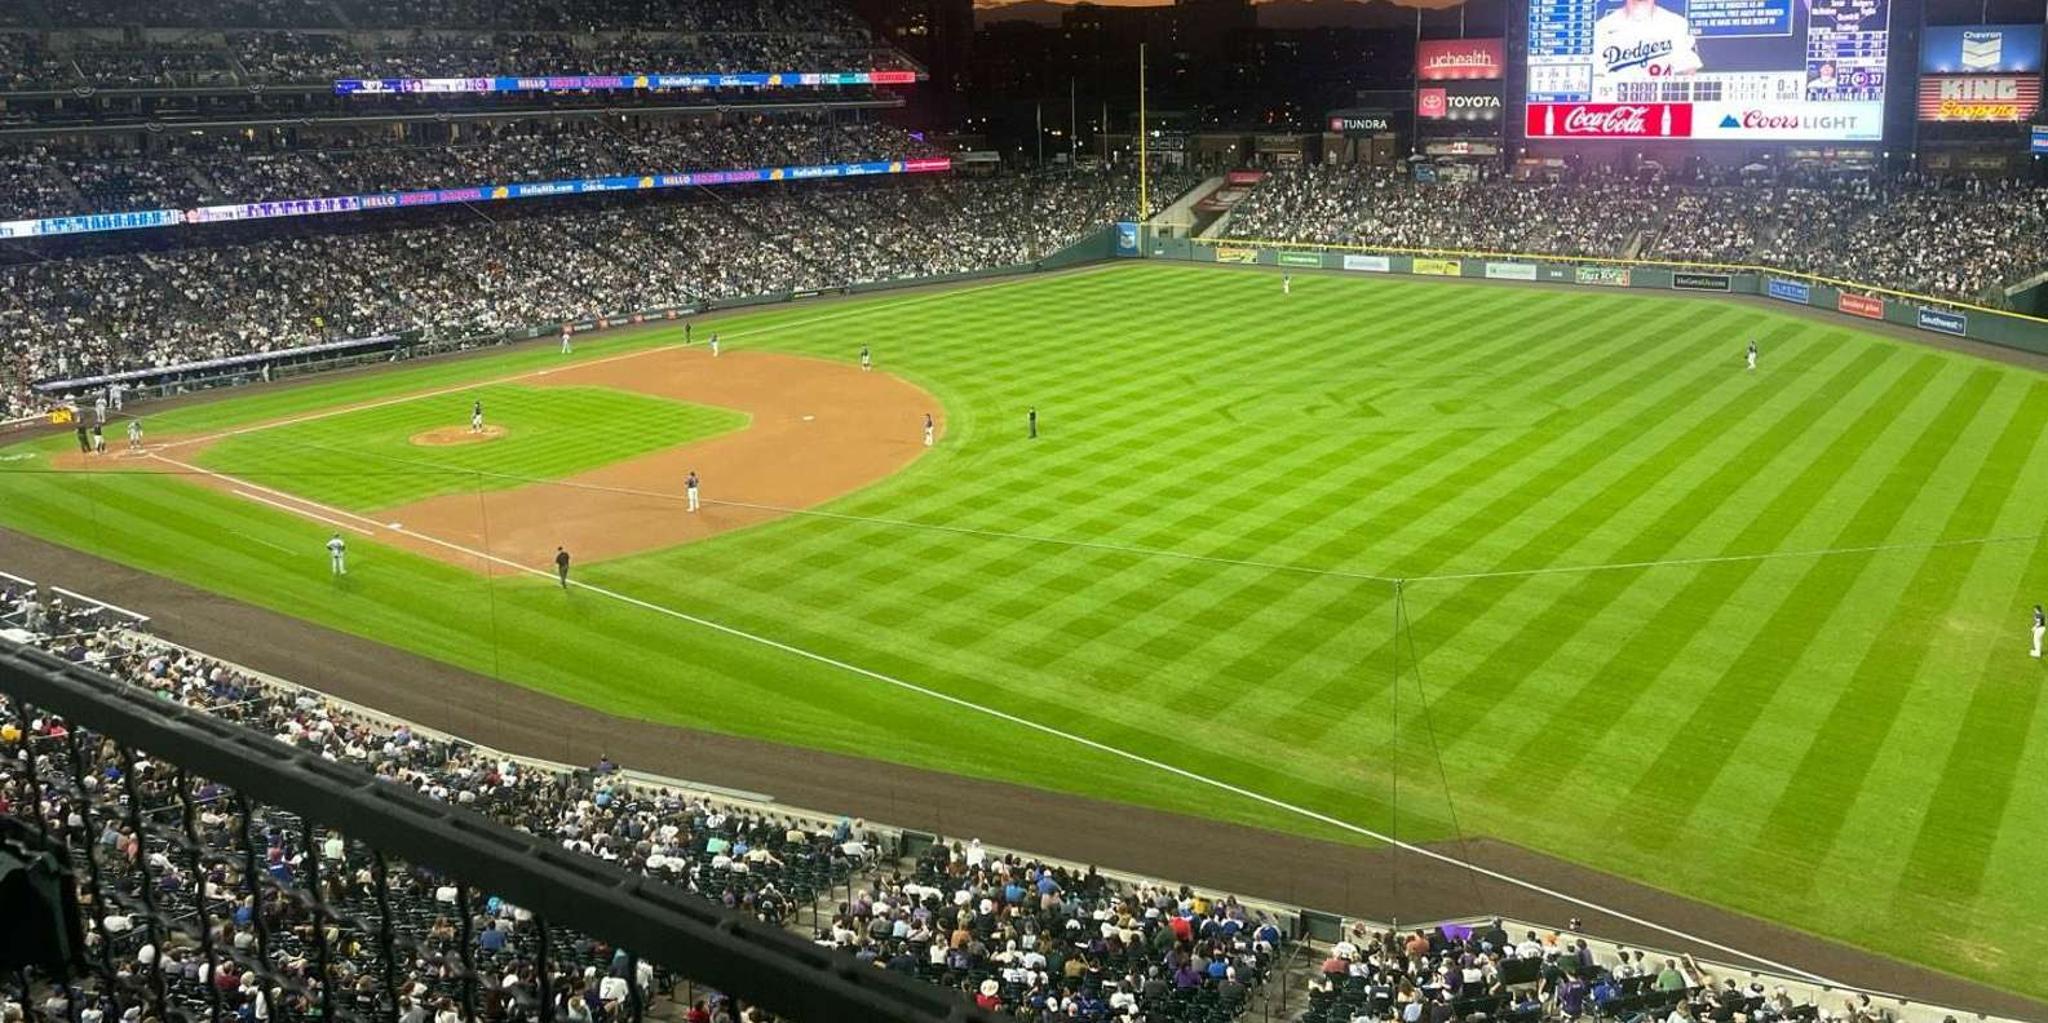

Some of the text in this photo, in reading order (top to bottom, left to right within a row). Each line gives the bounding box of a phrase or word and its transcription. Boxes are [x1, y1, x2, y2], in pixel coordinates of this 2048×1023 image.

[1963, 31, 2002, 39] Chevron
[1430, 50, 1492, 67] uchealth
[1602, 39, 1673, 68] Dodgers
[1940, 79, 2017, 99] KING
[1447, 96, 1501, 107] TOYOTA
[1344, 119, 1388, 129] TUNDRA
[1564, 106, 1650, 134] Coca-Cola
[1743, 109, 1858, 129] Coors LIGHT
[362, 195, 396, 208] HELLO
